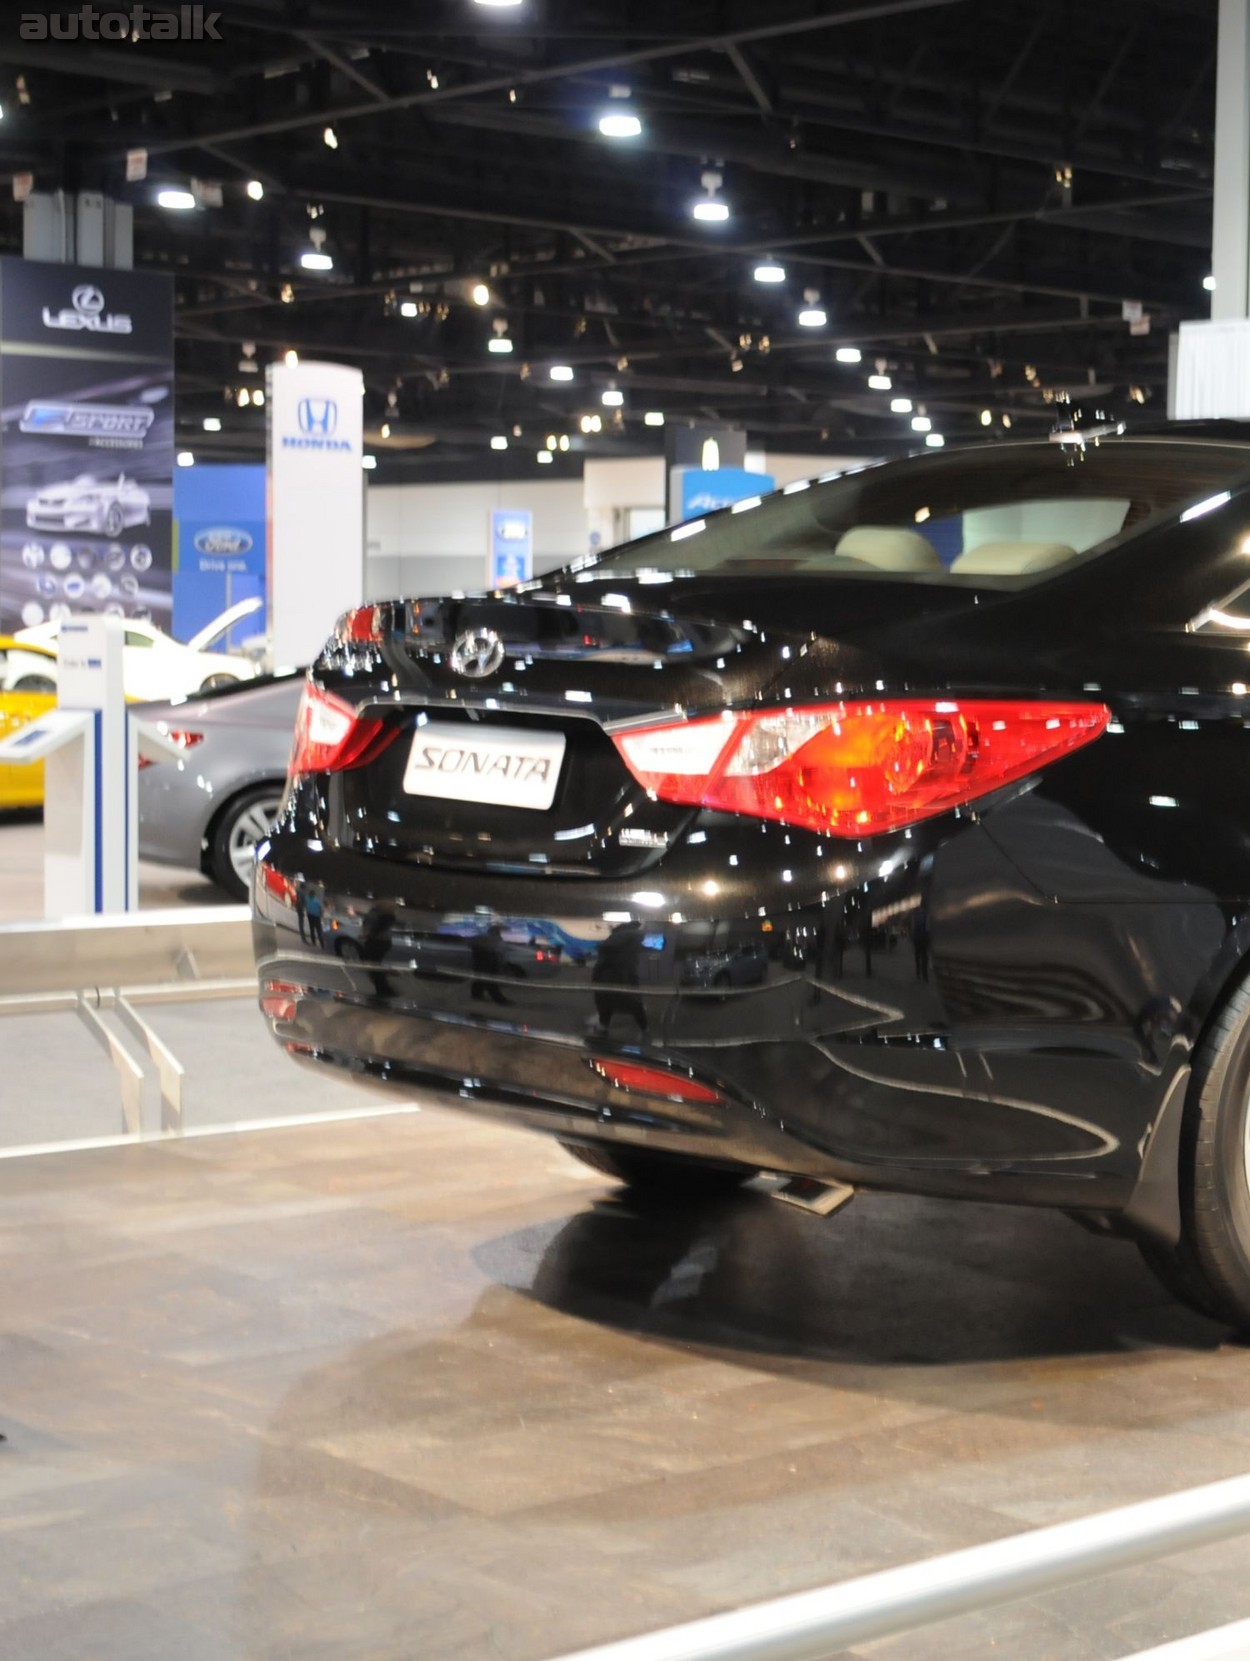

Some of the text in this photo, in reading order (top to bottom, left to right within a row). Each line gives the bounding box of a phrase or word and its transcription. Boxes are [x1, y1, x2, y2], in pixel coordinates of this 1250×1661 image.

[42, 305, 133, 334] LEXUS
[281, 437, 352, 452] HONDA
[414, 746, 552, 784] SONATA
